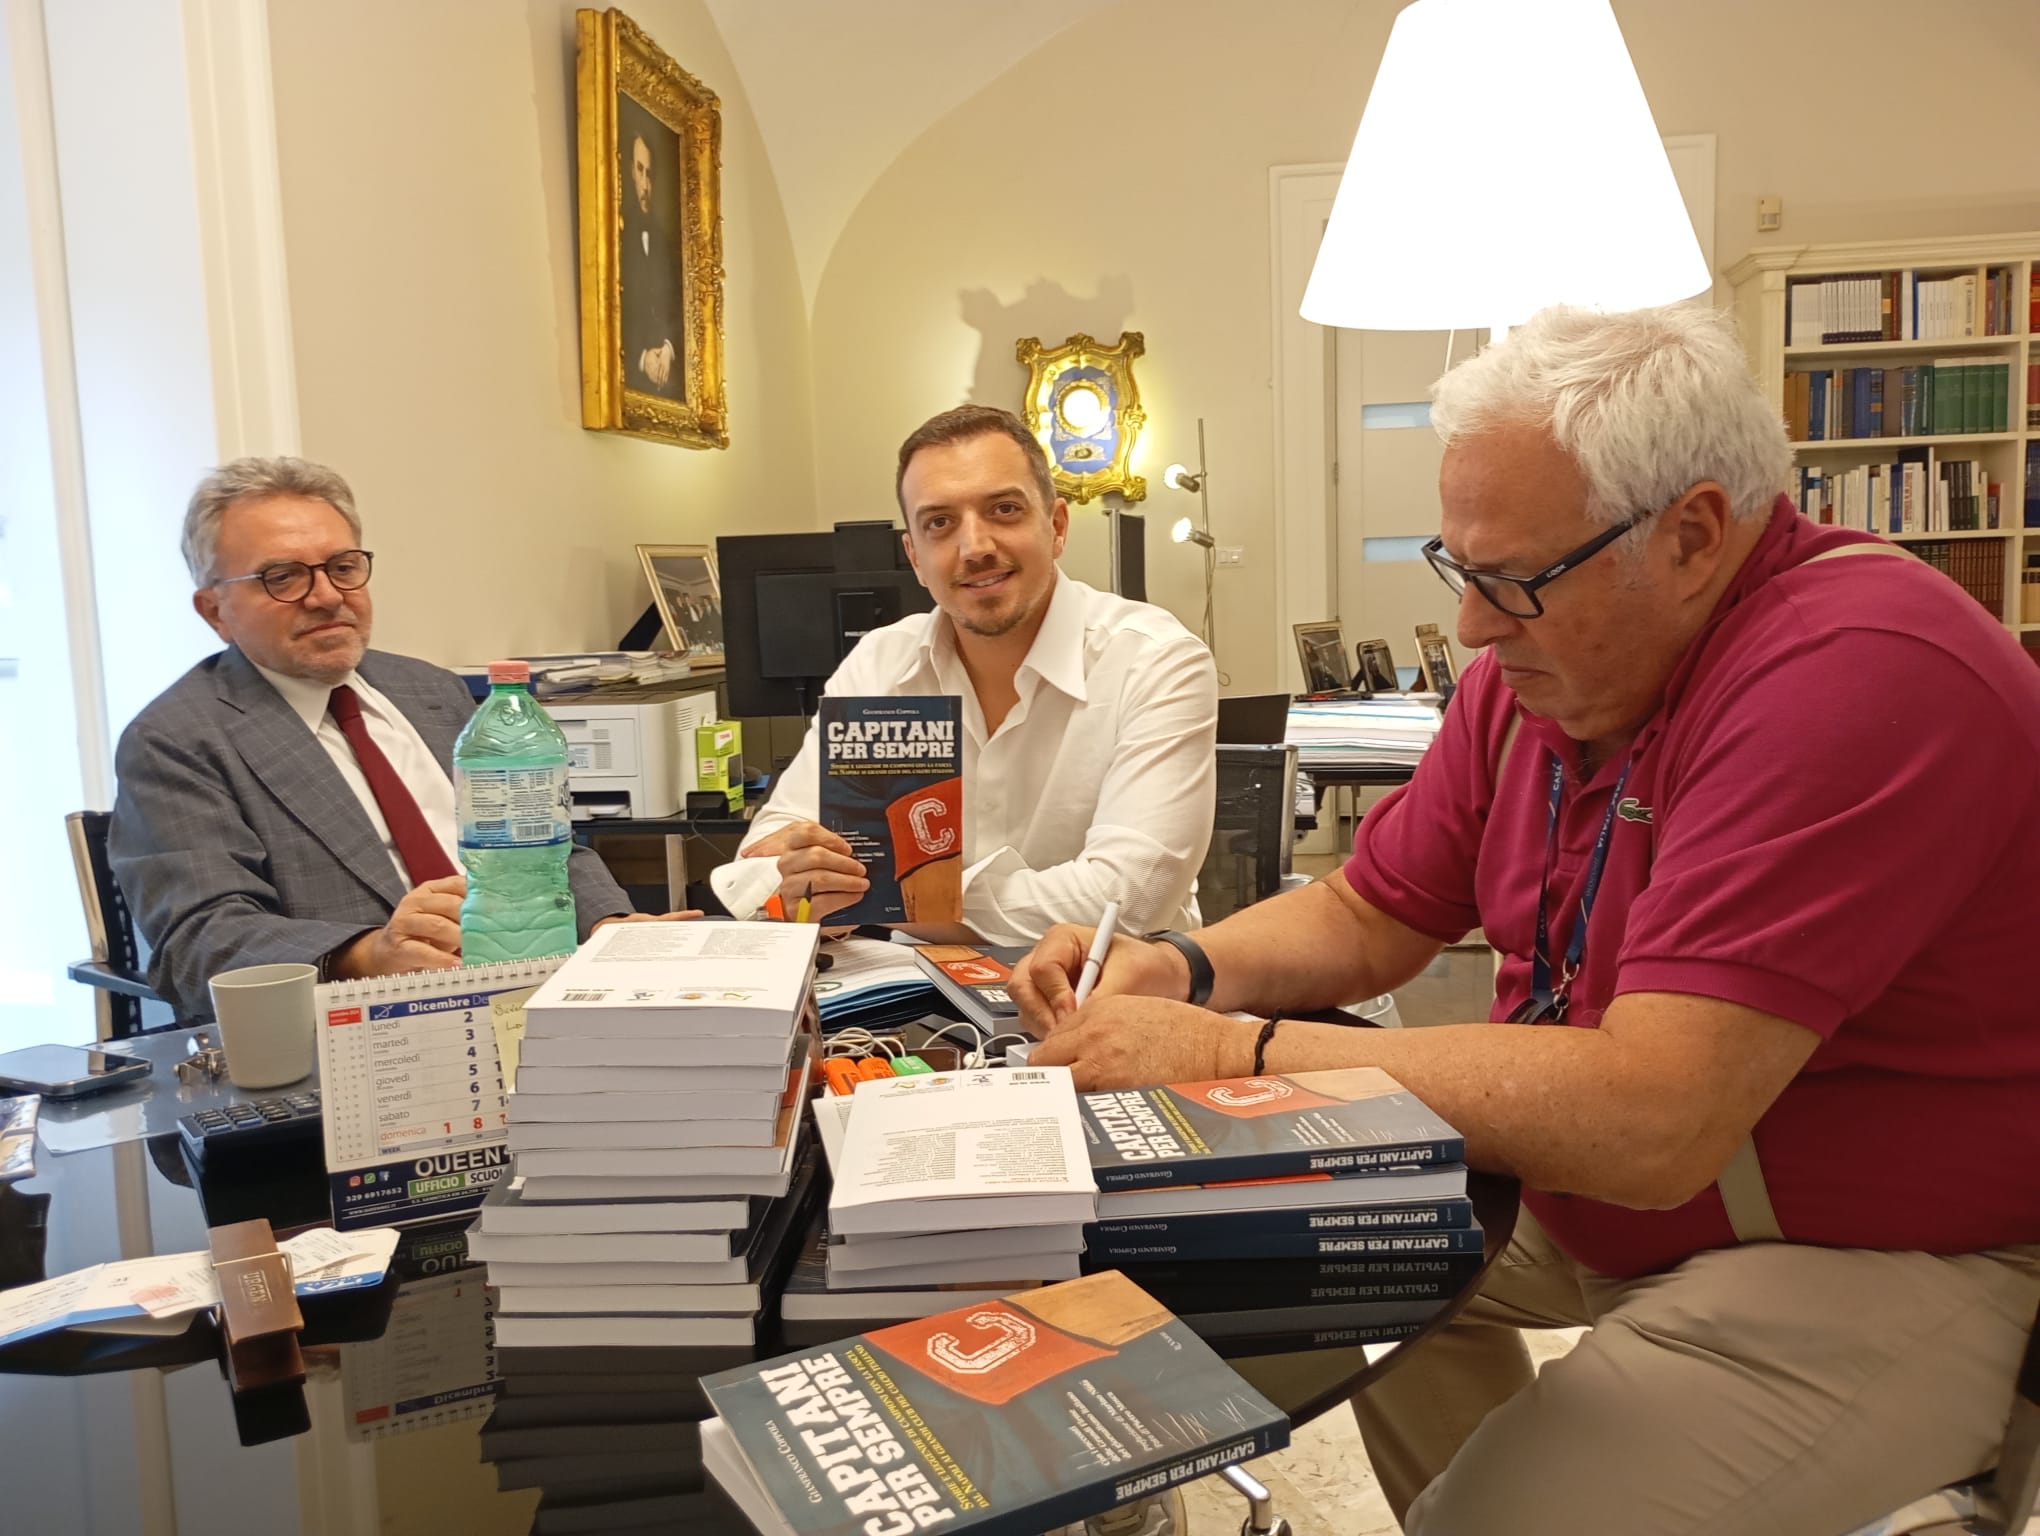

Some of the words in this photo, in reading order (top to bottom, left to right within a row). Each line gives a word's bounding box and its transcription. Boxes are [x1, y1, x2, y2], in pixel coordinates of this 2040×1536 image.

[828, 721, 954, 743] CAPITANI
[828, 743, 868, 760] PER
[873, 742, 954, 759] SEMPRE
[909, 798, 955, 855] C
[409, 998, 470, 1013] Dicembre
[464, 1011, 473, 1023] 2
[466, 1029, 475, 1040] 3
[467, 1046, 477, 1058] 4
[469, 1064, 478, 1076] 5
[470, 1082, 480, 1093] 6
[379, 1111, 409, 1122] sabato
[472, 1100, 481, 1111] 7
[1115, 1090, 1167, 1135] SEMPRE
[380, 1127, 426, 1140] domenica
[443, 1122, 452, 1134] 1
[473, 1117, 483, 1129] 8
[1085, 1093, 1156, 1160] CAPITANI
[1145, 1133, 1186, 1158] PER
[1310, 1154, 1355, 1169] SEMPRE
[1356, 1153, 1377, 1166] PER
[1380, 1149, 1433, 1164] CAPITANI
[416, 1177, 459, 1193] UFFICIO
[1309, 1216, 1354, 1227] SEMPRE
[1358, 1215, 1379, 1225] PER
[1382, 1212, 1438, 1224] CAPITANI
[1318, 1240, 1365, 1251] SEMPRE
[1368, 1240, 1389, 1250] PER
[1392, 1238, 1448, 1249] CAPITANI
[801, 1352, 906, 1463] SEMPRE
[765, 1418, 793, 1455] COPPOLA
[759, 1361, 916, 1536] CAPITANI
[1196, 1441, 1255, 1472] CAPITANI
[784, 1450, 823, 1504] GIANFRANCO
[1169, 1464, 1195, 1480] PER
[1116, 1471, 1168, 1500] SEMPRE
[883, 1463, 956, 1526] PER
